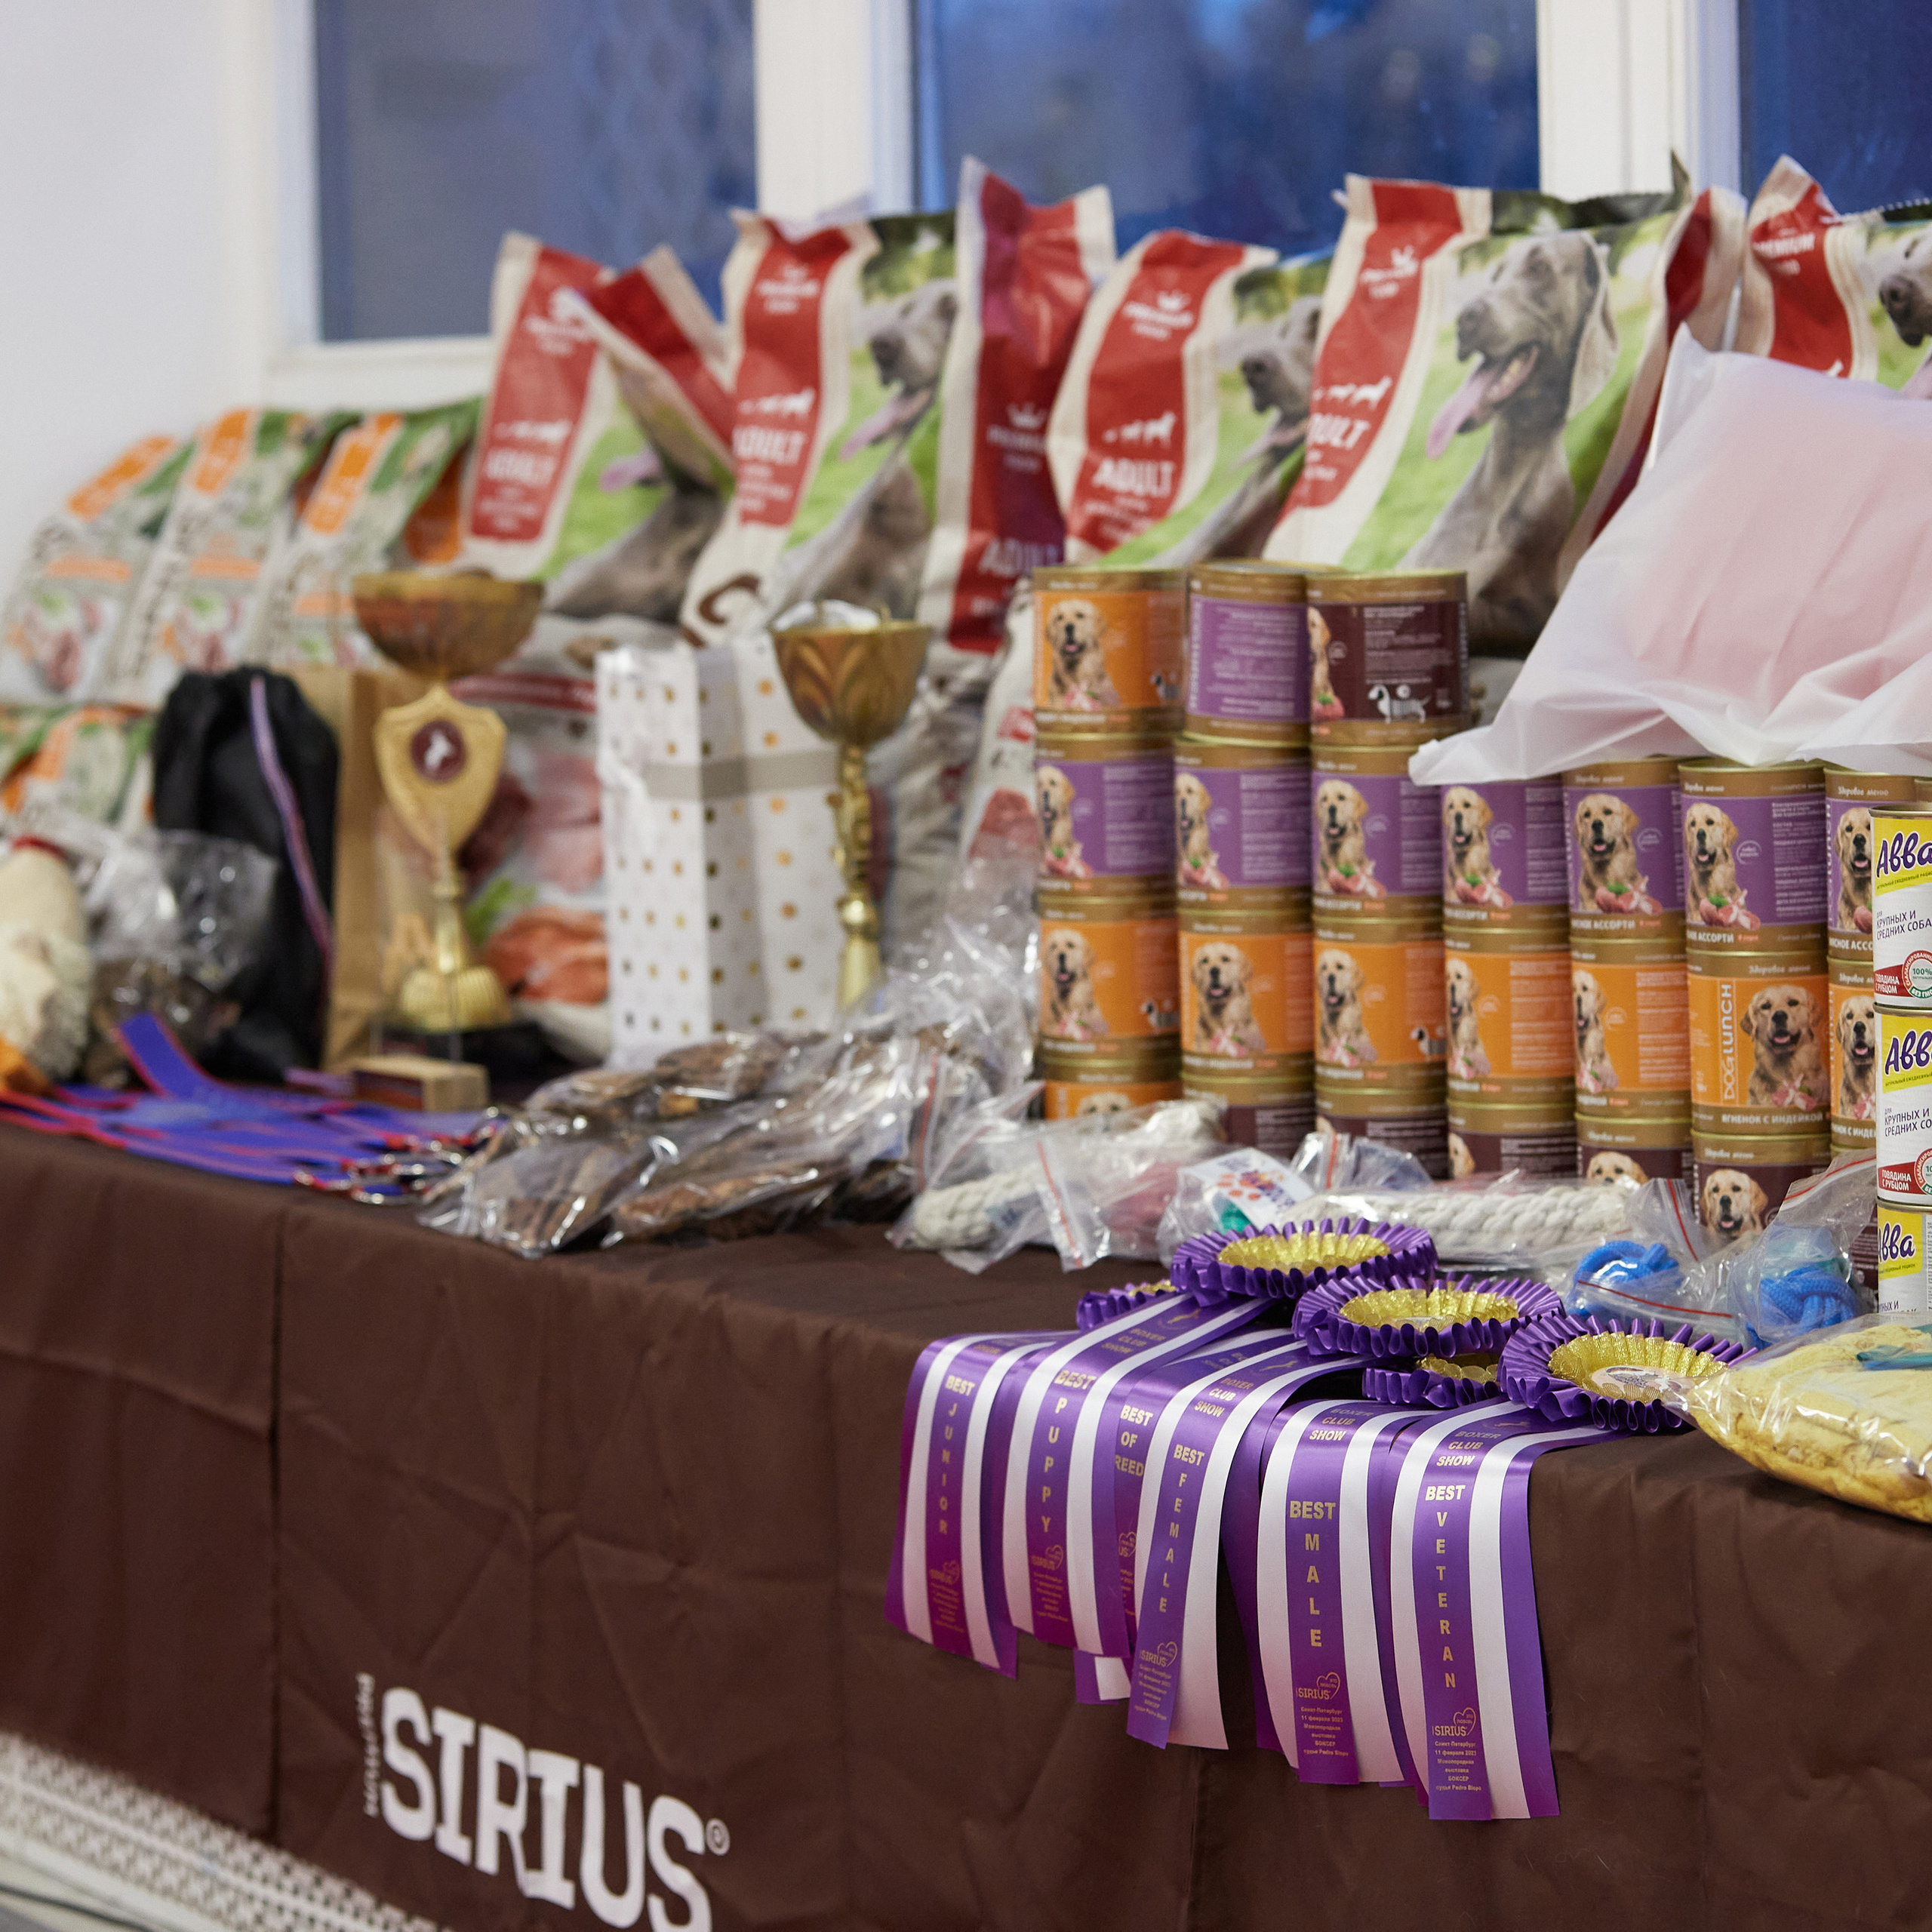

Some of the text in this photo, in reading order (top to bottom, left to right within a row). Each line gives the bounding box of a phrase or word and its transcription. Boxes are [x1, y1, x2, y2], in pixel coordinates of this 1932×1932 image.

[1593, 919, 1635, 931] АССОРТИ
[1877, 910, 1916, 929] КРУПНЫХ И
[1698, 933, 1734, 943] АССОРТИ
[1877, 924, 1905, 940] СРЕДНИХ
[1884, 1107, 1930, 1125] КРУПНЫХ И
[1884, 1121, 1918, 1137] СРЕДНИХ
[1881, 1169, 1912, 1182] ГОВЯДИНА
[1885, 1180, 1909, 1191] РУБЦОМ
[945, 1374, 975, 1396] BEST
[1054, 1370, 1097, 1389] BEST
[1220, 1377, 1254, 1390] BOXER
[1208, 1387, 1236, 1401] CLUB
[1120, 1404, 1153, 1426] BEST
[1195, 1401, 1225, 1417] SHOW
[1321, 1417, 1355, 1425] CLUB
[1121, 1431, 1137, 1447] OF
[1309, 1429, 1346, 1441] SHOW
[1455, 1431, 1502, 1439] BOXER
[1448, 1441, 1484, 1450] CLUB
[1174, 1444, 1204, 1466] BEST
[1436, 1455, 1475, 1466] SHOW
[1041, 1397, 1068, 1533] PUPPY
[1115, 1454, 1144, 1477] REED
[1425, 1484, 1466, 1501] BEST
[1290, 1500, 1337, 1520] BEST
[1159, 1472, 1187, 1613] FEMALE
[1305, 1533, 1321, 1647] MALE
[1435, 1512, 1456, 1688] VETERAN
[1298, 1687, 1330, 1700] SIRIUS
[1435, 1725, 1466, 1737] SIRIUS
[380, 1685, 713, 1932] SIRIUS
